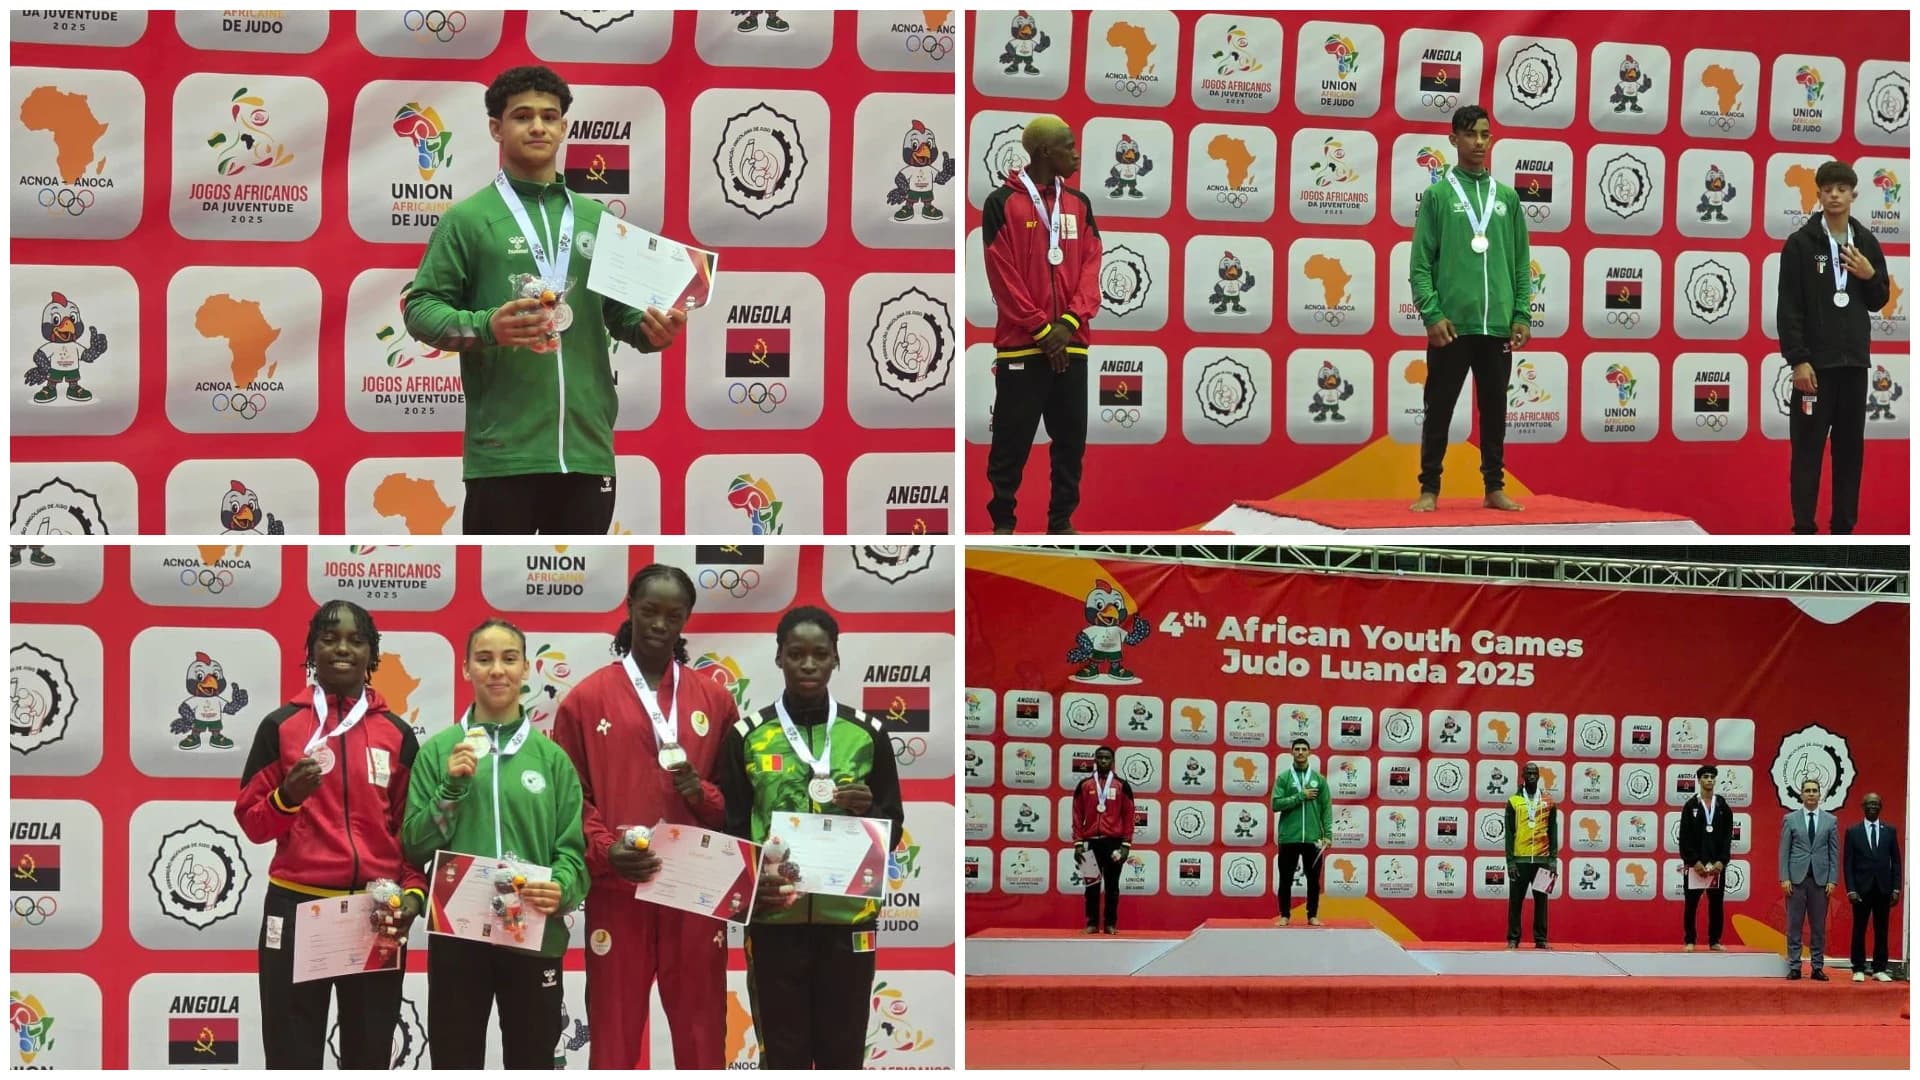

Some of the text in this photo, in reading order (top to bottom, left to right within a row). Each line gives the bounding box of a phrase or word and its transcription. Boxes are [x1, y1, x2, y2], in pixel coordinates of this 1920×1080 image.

[43, 10, 118, 21] JUVENTUDE
[53, 22, 86, 31] 2025
[222, 20, 283, 34] DE JUDO
[891, 24, 924, 33] ACNOA
[1422, 49, 1462, 62] ANGOLA
[1201, 79, 1272, 92] JOGOS AFRICANOS
[1321, 80, 1357, 91] UNION
[1223, 90, 1263, 99] JUVENTUDE
[1320, 98, 1355, 107] DE JUDO
[1793, 108, 1823, 118] UNION
[568, 120, 632, 140] ANGOLA
[1791, 124, 1822, 132] DE JUDO
[1515, 160, 1554, 172] ANGOLA
[20, 176, 114, 188] ACNOA ANOCA
[189, 184, 309, 202] JOGOS AFRICANOS
[391, 183, 453, 200] UNION
[1300, 190, 1369, 203] JOGOS AFRICANOS
[202, 202, 294, 213] DA JUVENTUDE
[1320, 201, 1361, 209] JUVENTUDE
[230, 215, 264, 224] 2025
[391, 214, 410, 227] DE
[1871, 211, 1900, 220] UNION
[1870, 226, 1881, 234] DE
[1606, 267, 1643, 280] ANGOLA
[727, 305, 791, 325] ANGOLA
[1100, 360, 1144, 373] ANGOLA
[1694, 371, 1731, 383] ANGOLA
[195, 382, 285, 392] ACNOA ANOCA
[361, 376, 402, 393] JOGOS
[375, 394, 464, 405] DA JUVENTUDE
[404, 407, 435, 415] 2025
[1520, 412, 1560, 422] AFRICANOS
[1604, 408, 1637, 417] UNION
[886, 485, 949, 505] ANGOLA
[163, 558, 252, 569] ACNOA ANOCA
[527, 555, 586, 571] UNION
[324, 562, 441, 579] JOGOS AFRICANOS
[338, 579, 427, 590] DA JUVENTUDE
[526, 583, 584, 596] DE JUDO
[366, 591, 398, 599] 2025
[1159, 611, 1584, 658] 4th African Youth Games
[1220, 648, 1535, 687] Judo Luanda 2025
[863, 665, 931, 683] ANGOLA
[882, 920, 919, 932] JUDO
[170, 996, 240, 1014] ANGOLA
